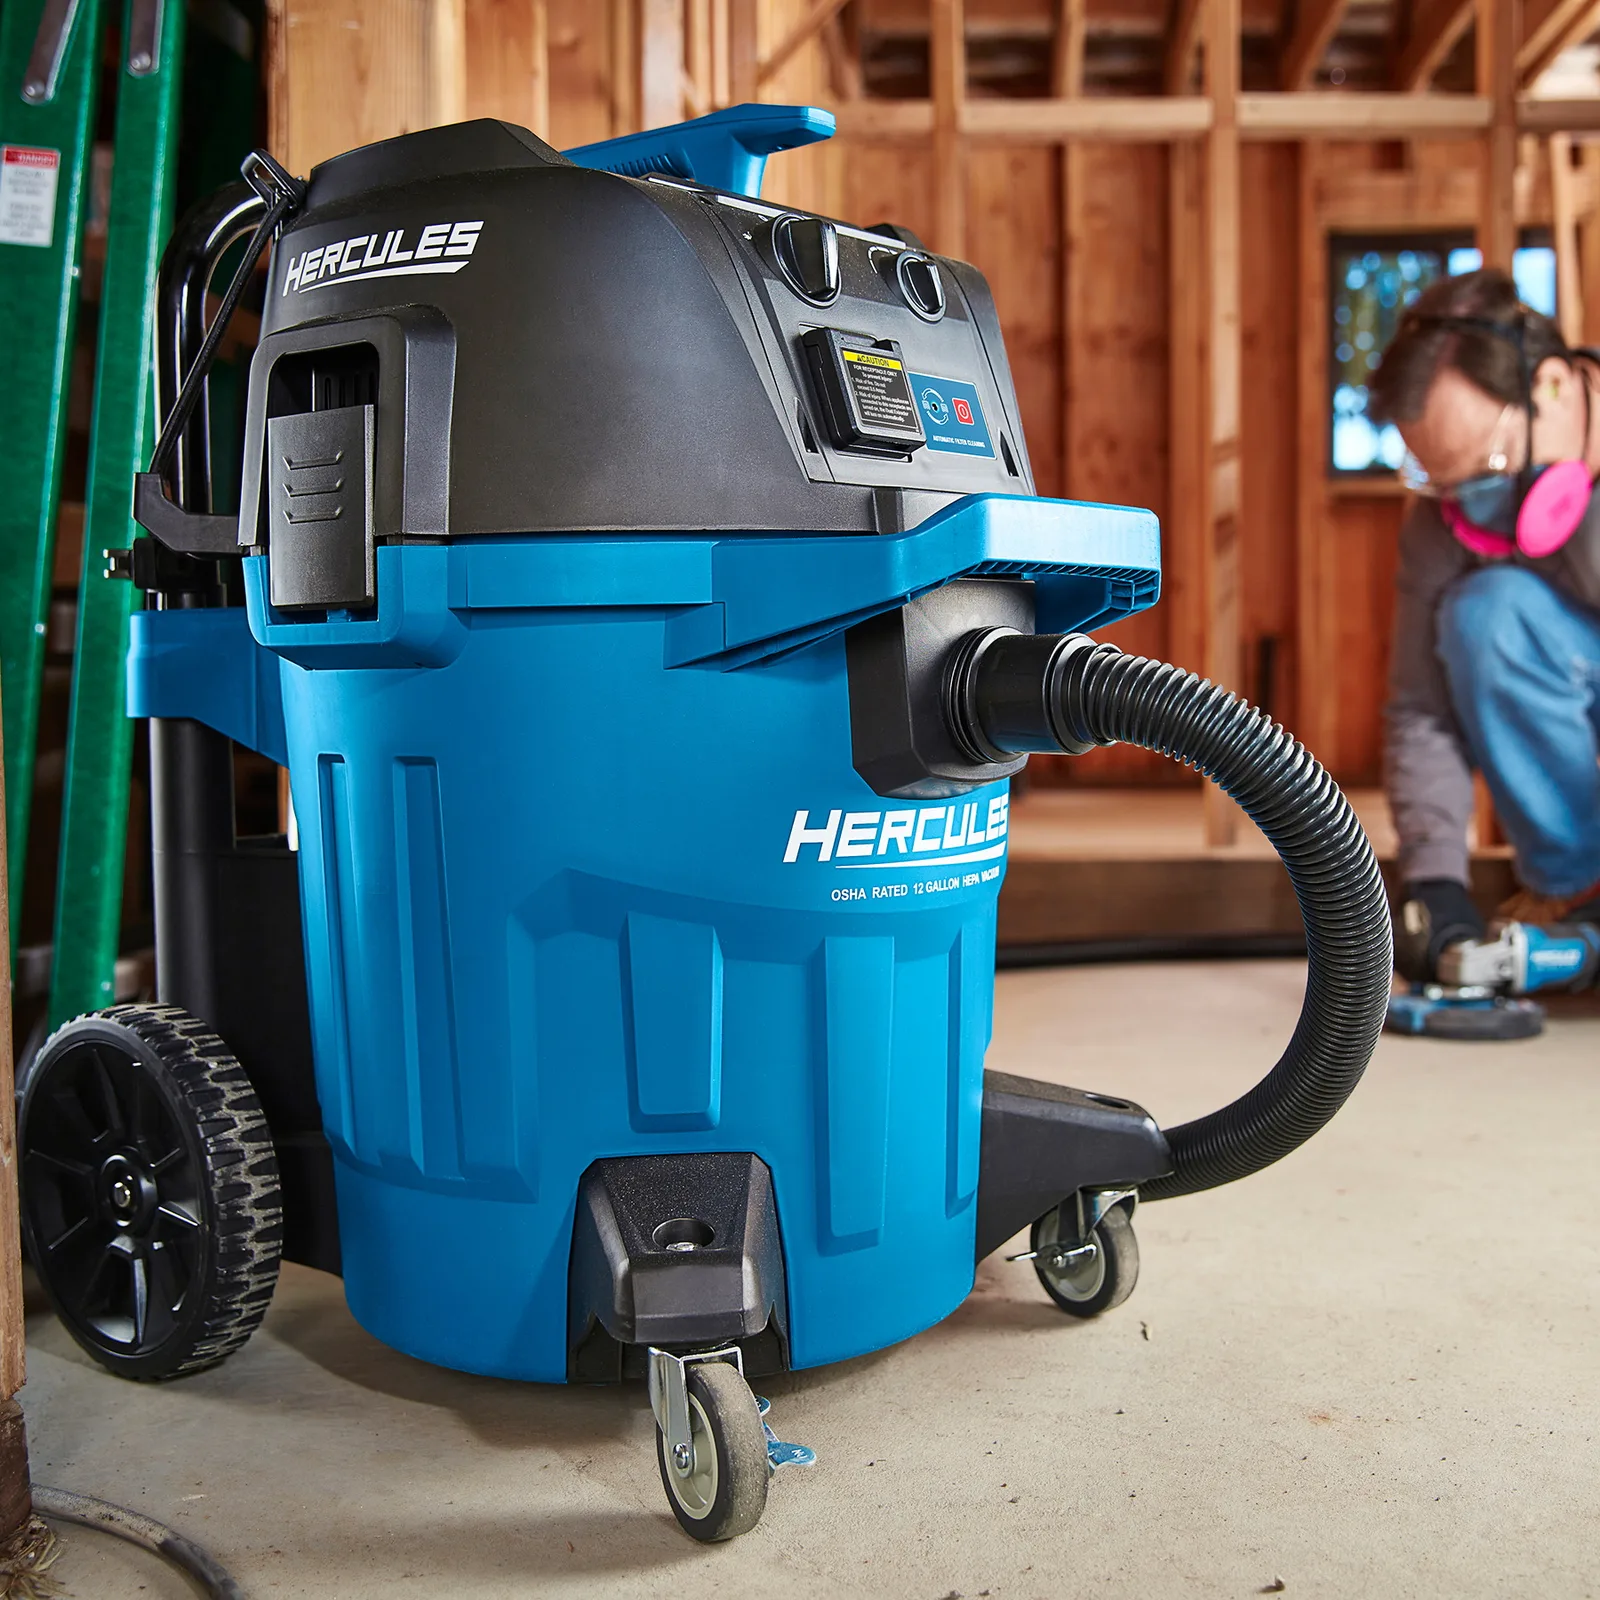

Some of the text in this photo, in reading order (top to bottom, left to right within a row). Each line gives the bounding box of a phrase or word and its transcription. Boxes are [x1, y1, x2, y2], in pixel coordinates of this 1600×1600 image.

[283, 221, 484, 297] HERCULES
[861, 355, 889, 366] CAUTION
[782, 792, 1009, 862] HERCULES
[831, 866, 1000, 901] OSHA RATED 12 GALLON HEPA VACUUM
